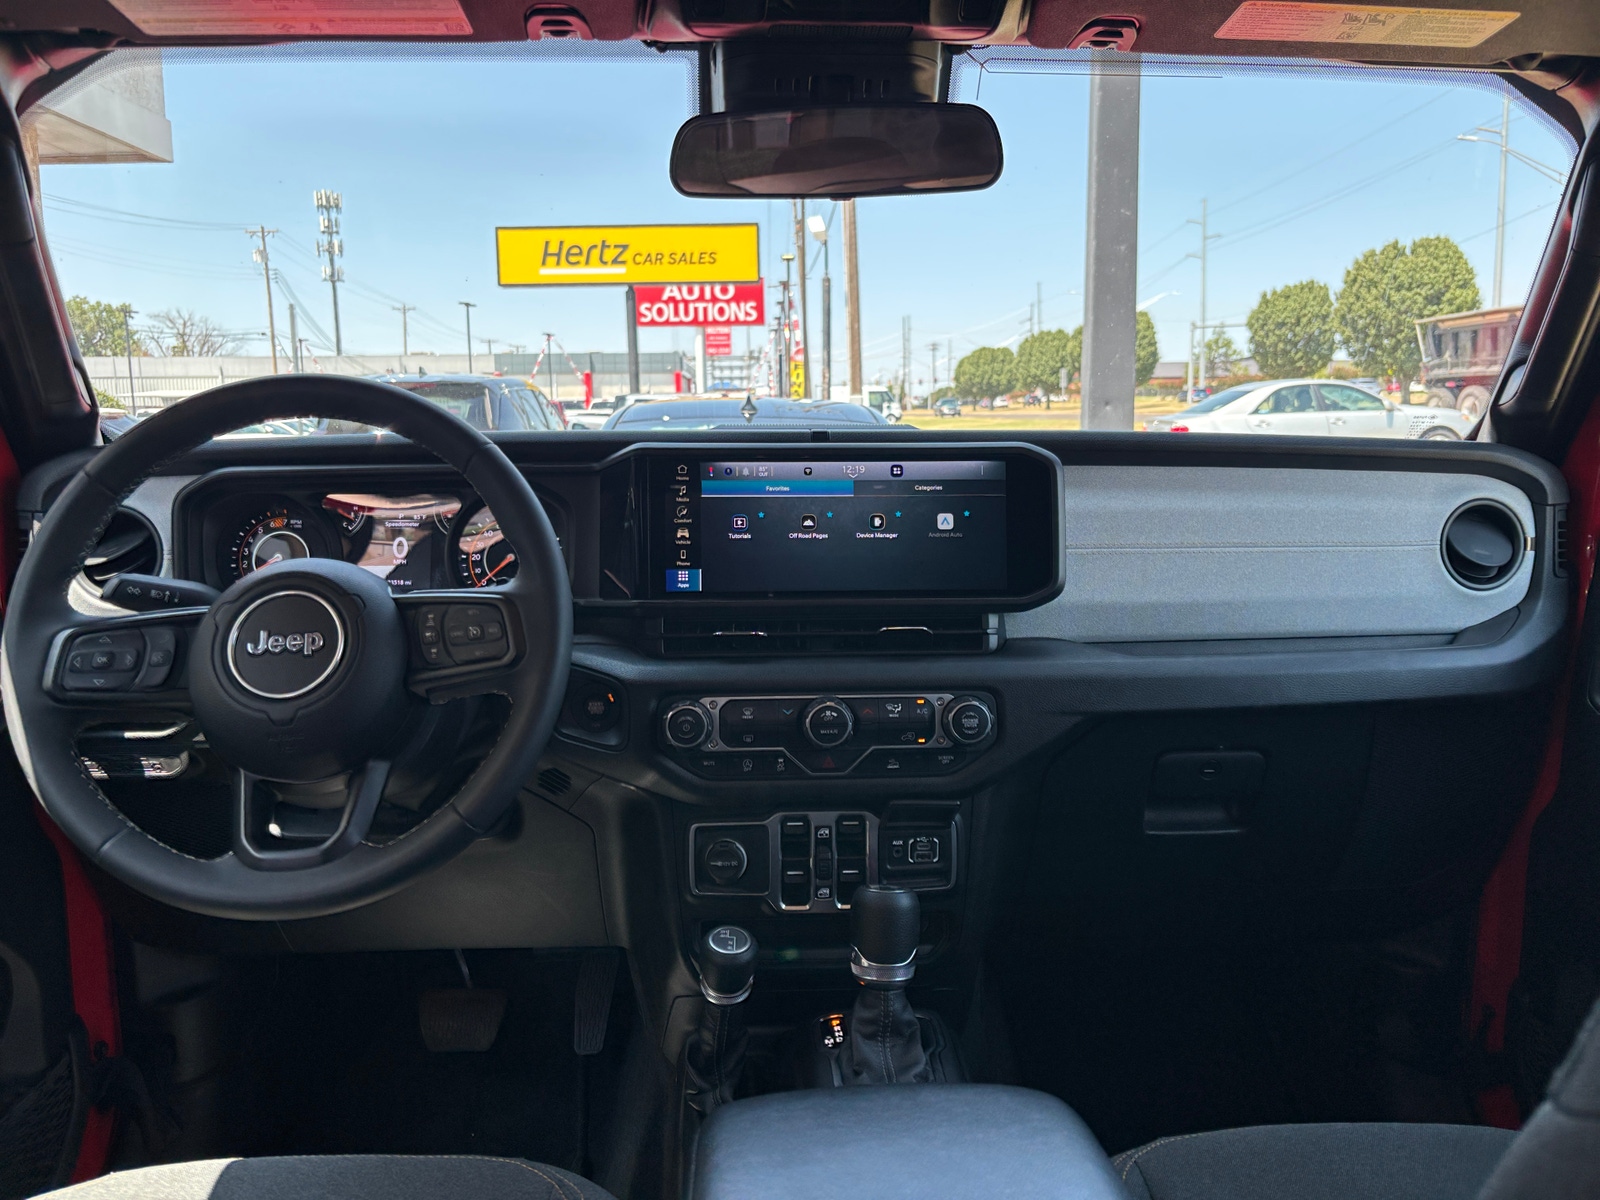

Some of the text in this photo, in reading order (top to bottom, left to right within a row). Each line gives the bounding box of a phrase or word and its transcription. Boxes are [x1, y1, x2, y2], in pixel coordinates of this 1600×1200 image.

[540, 240, 717, 267] Hertz CAR SALES
[661, 284, 735, 301] AUTO
[639, 301, 758, 323] SOLUTIONS
[842, 466, 866, 474] 12:19
[244, 547, 249, 555] 3
[392, 536, 409, 558] 0
[246, 630, 324, 655] Jeep
